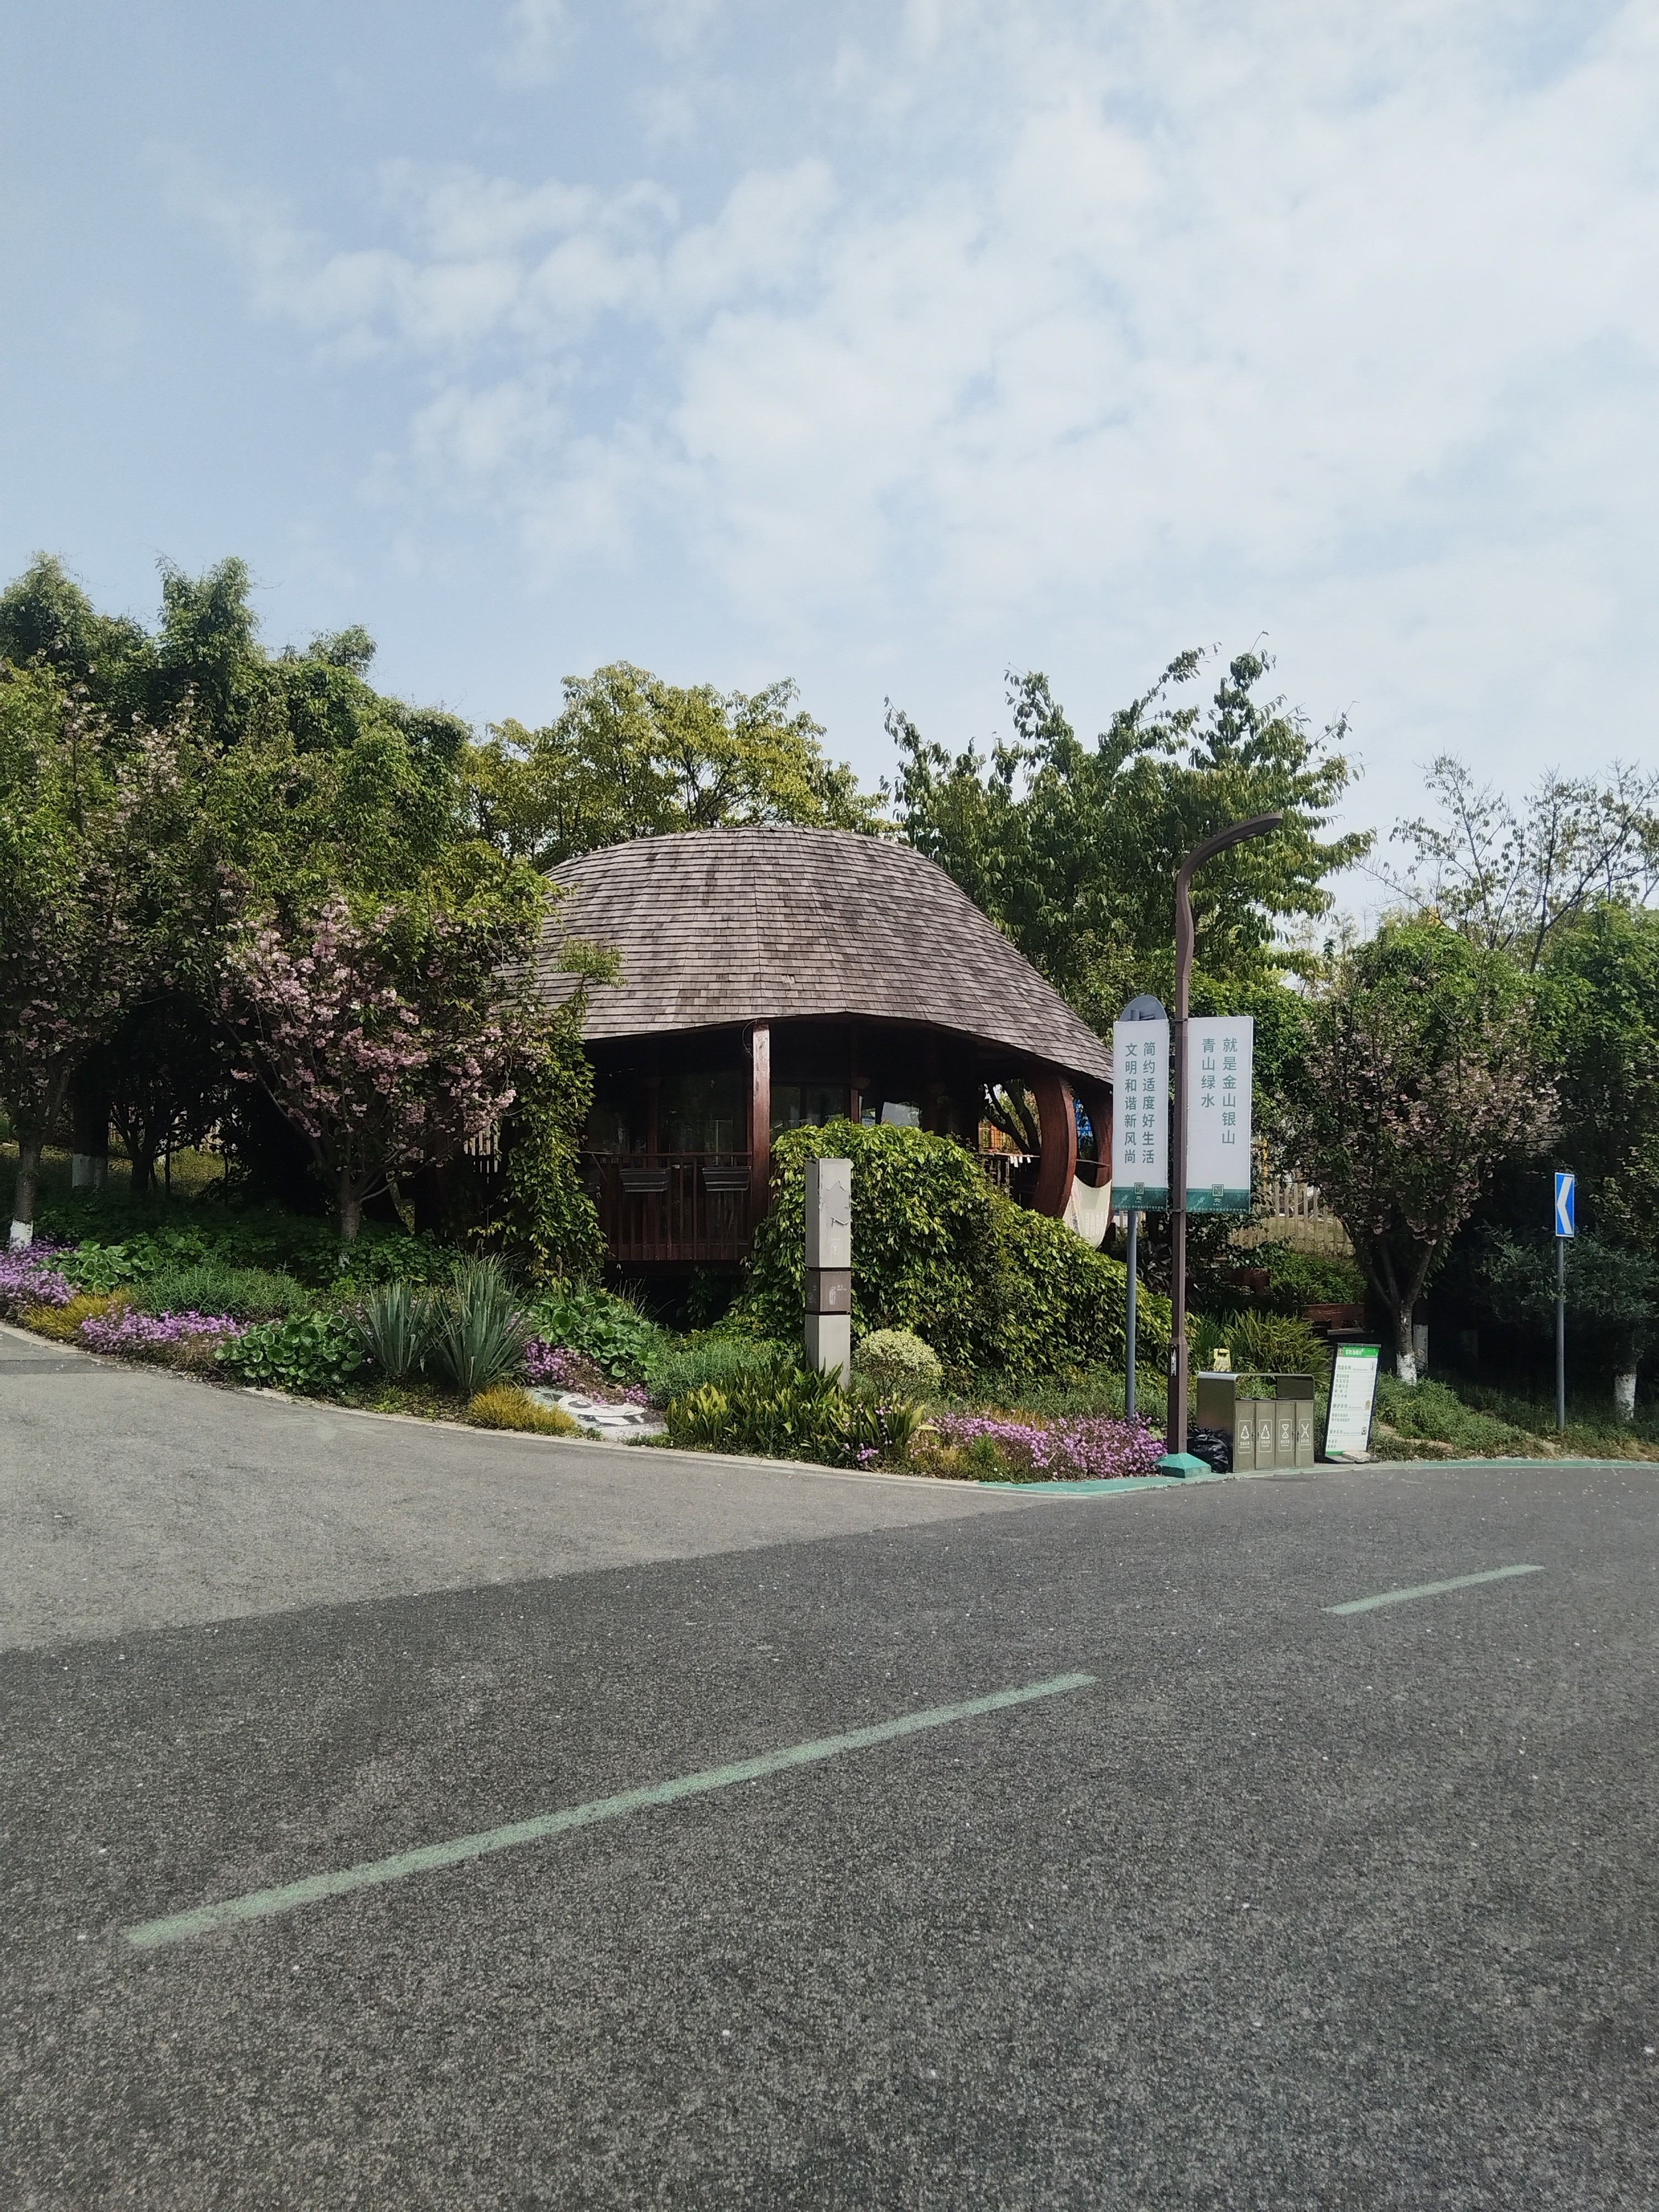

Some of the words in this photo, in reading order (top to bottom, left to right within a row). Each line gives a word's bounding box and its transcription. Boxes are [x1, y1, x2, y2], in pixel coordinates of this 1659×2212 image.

[1124, 1042, 1138, 1165] 文明和谐新风尚
[1142, 1041, 1156, 1165] 简约适度好生活
[1201, 1038, 1216, 1108] 青山绿水
[1222, 1037, 1238, 1145] 就是金山银山
